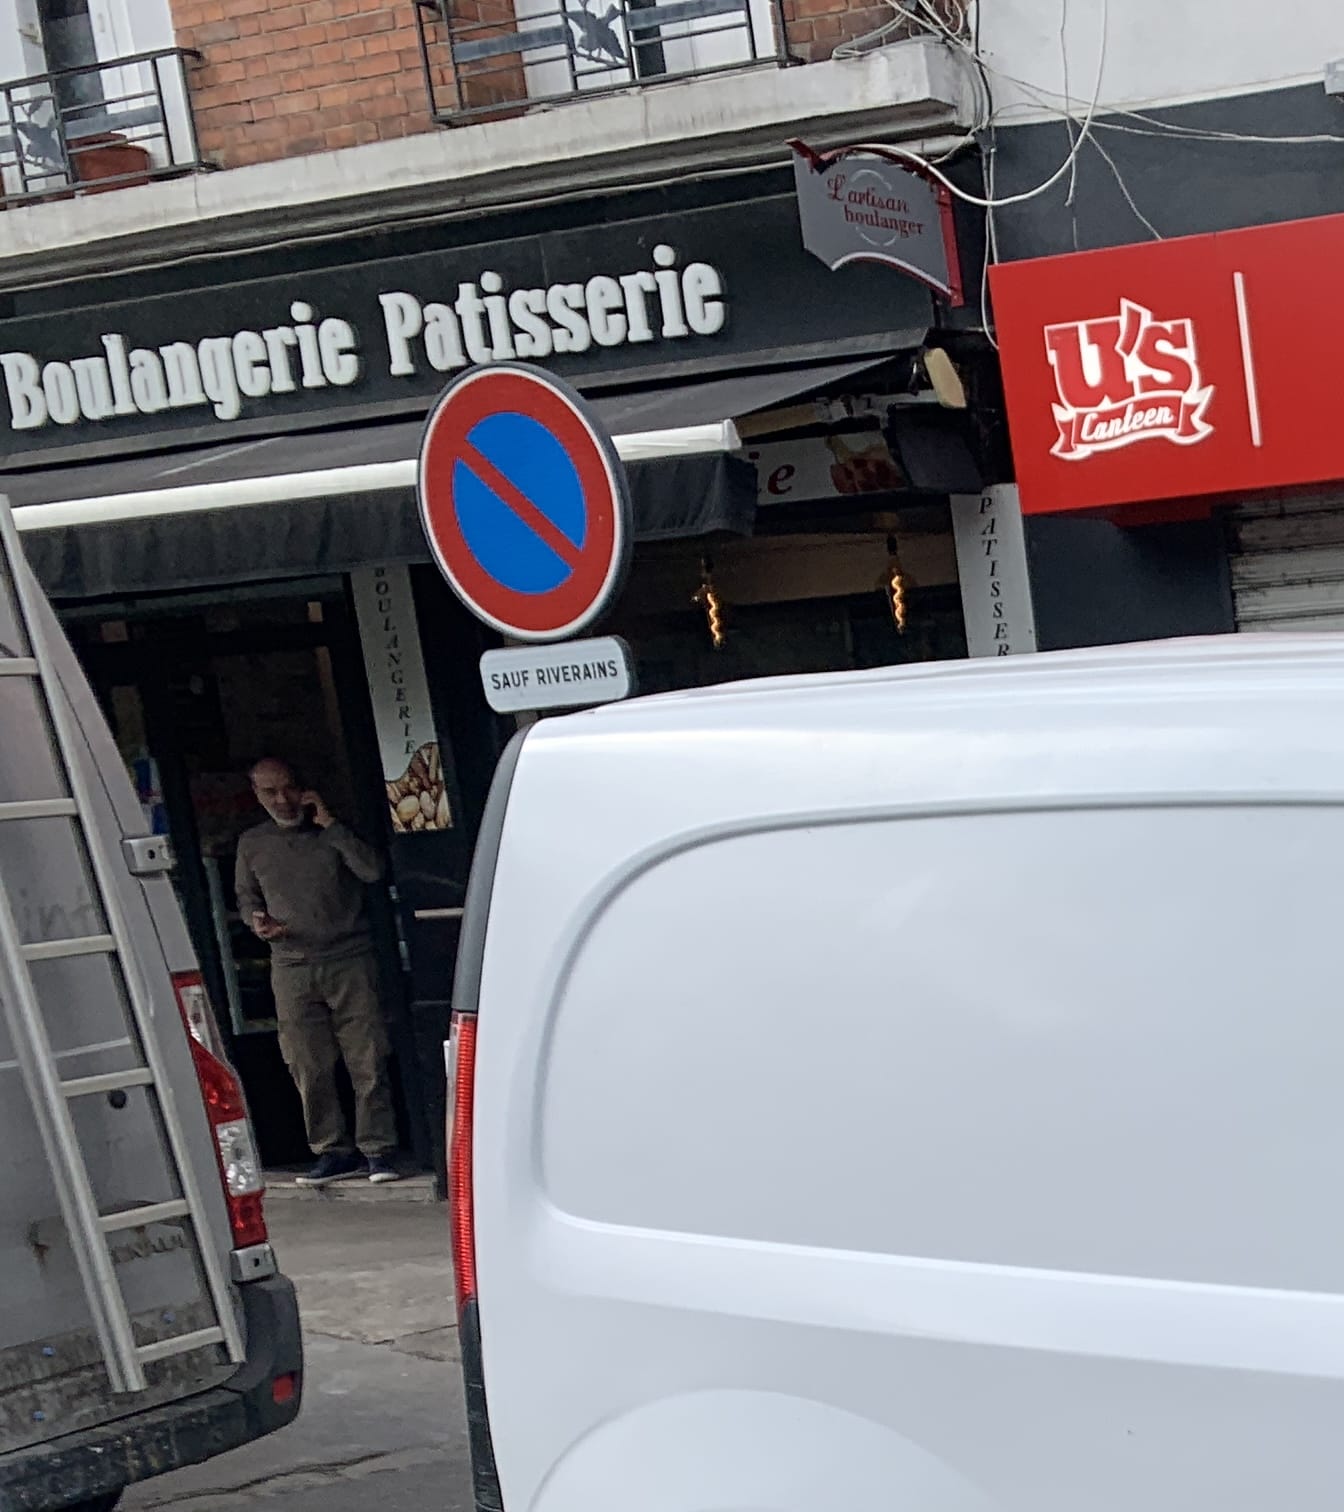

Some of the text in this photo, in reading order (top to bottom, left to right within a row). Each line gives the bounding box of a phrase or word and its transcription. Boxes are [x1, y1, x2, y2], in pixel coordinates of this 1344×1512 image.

[827, 174, 911, 214] L'artisan
[844, 203, 924, 239] boulanger
[1, 244, 727, 430] Boulangerie Patisserie
[1079, 402, 1175, 442] Canteen
[491, 660, 618, 690] SAUF RIVERAINS
